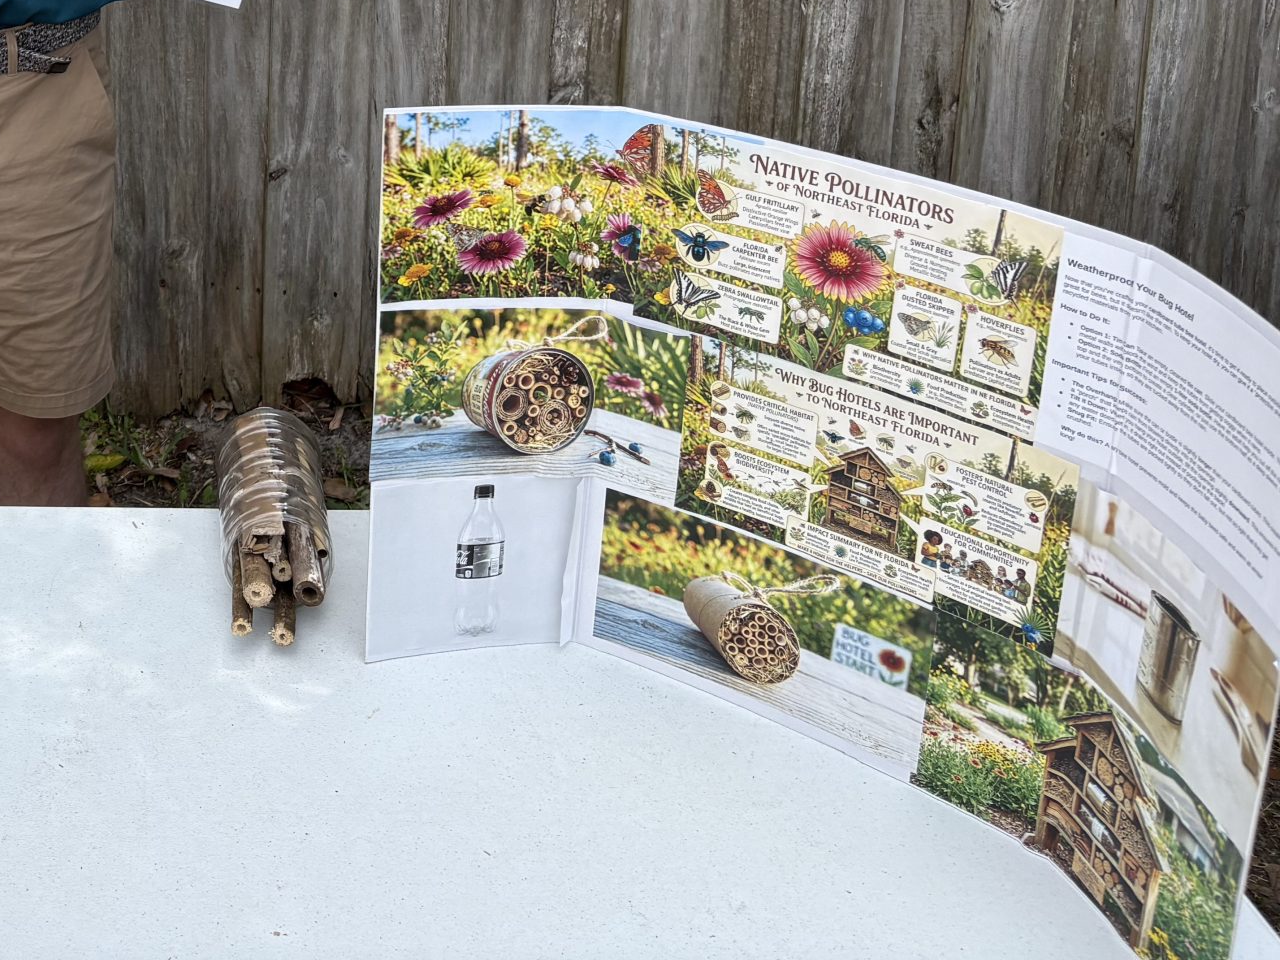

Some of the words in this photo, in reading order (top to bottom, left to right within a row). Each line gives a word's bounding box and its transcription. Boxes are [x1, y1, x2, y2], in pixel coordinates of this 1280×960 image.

[750, 154, 819, 186] NATIVE
[825, 172, 954, 224] POLLINATORS
[746, 194, 762, 202] GULF
[764, 197, 799, 212] FRITILLARY
[777, 182, 790, 192] OF
[793, 184, 863, 212] NORTHEAST
[867, 206, 920, 229] FLORIDA
[732, 246, 767, 261] CARPENTER
[768, 255, 778, 264] BEE
[744, 242, 768, 254] FLORIDA
[910, 240, 935, 252] SWEAT
[936, 247, 953, 258] BEES
[718, 285, 736, 295] ZEBRA
[737, 291, 779, 307] SWALLOWTAIL
[1136, 283, 1157, 298] Your
[1158, 293, 1174, 310] Bug
[980, 316, 1025, 335] HOVERFLIES
[862, 352, 876, 362] WHY
[878, 356, 900, 369] NATIVE
[901, 363, 943, 384] POLLINATORS
[944, 377, 969, 393] MATTER
[971, 388, 978, 396] IN
[979, 391, 988, 400] NE
[989, 394, 1016, 409] FLORIDA
[733, 391, 762, 404] PROVIDES
[763, 400, 788, 413] CRITICAL
[789, 409, 814, 421] HABITAT
[775, 367, 806, 386] WHY
[809, 378, 833, 396] BUG
[836, 389, 881, 412] HOTELS
[883, 405, 905, 421] ARE
[908, 412, 979, 446] IMPORTANT
[806, 393, 819, 404] TO
[822, 396, 888, 427] NORTHEAST
[891, 421, 940, 446] FLORIDA
[808, 525, 829, 538] IMPACT
[830, 533, 861, 549] SUMMARY
[861, 545, 873, 555] FOR
[875, 550, 882, 558] NE
[884, 554, 909, 569] FLORIDA
[941, 527, 984, 549] EDUCATIONAL
[985, 545, 1029, 566] OPPORTUNITY
[968, 545, 1013, 568] COMMUNITIES
[842, 627, 870, 646] BUG
[836, 640, 876, 666] HOTEL
